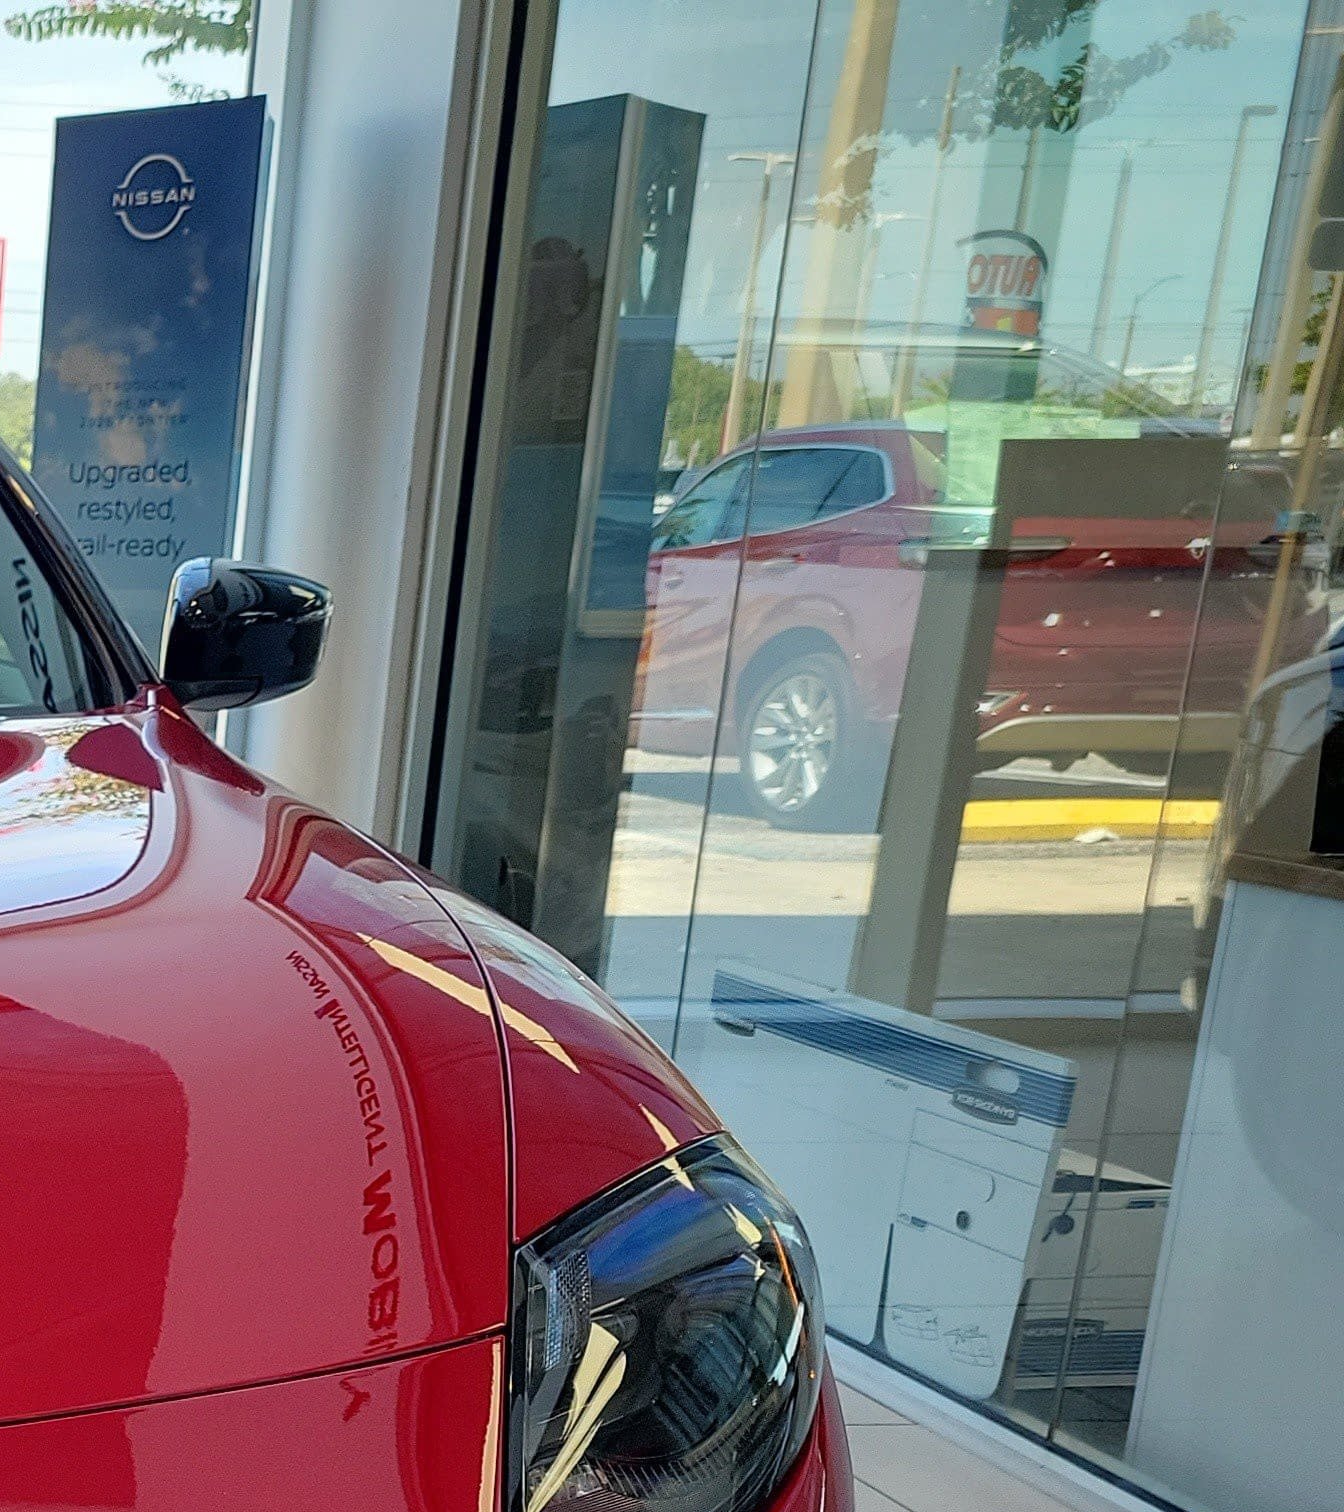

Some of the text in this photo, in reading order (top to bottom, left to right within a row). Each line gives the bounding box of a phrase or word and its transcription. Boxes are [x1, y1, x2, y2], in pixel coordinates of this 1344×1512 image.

[113, 185, 195, 206] NISSAN
[70, 461, 191, 489] Upgraded,
[78, 498, 174, 524] restyled,
[77, 535, 187, 561] ail-ready
